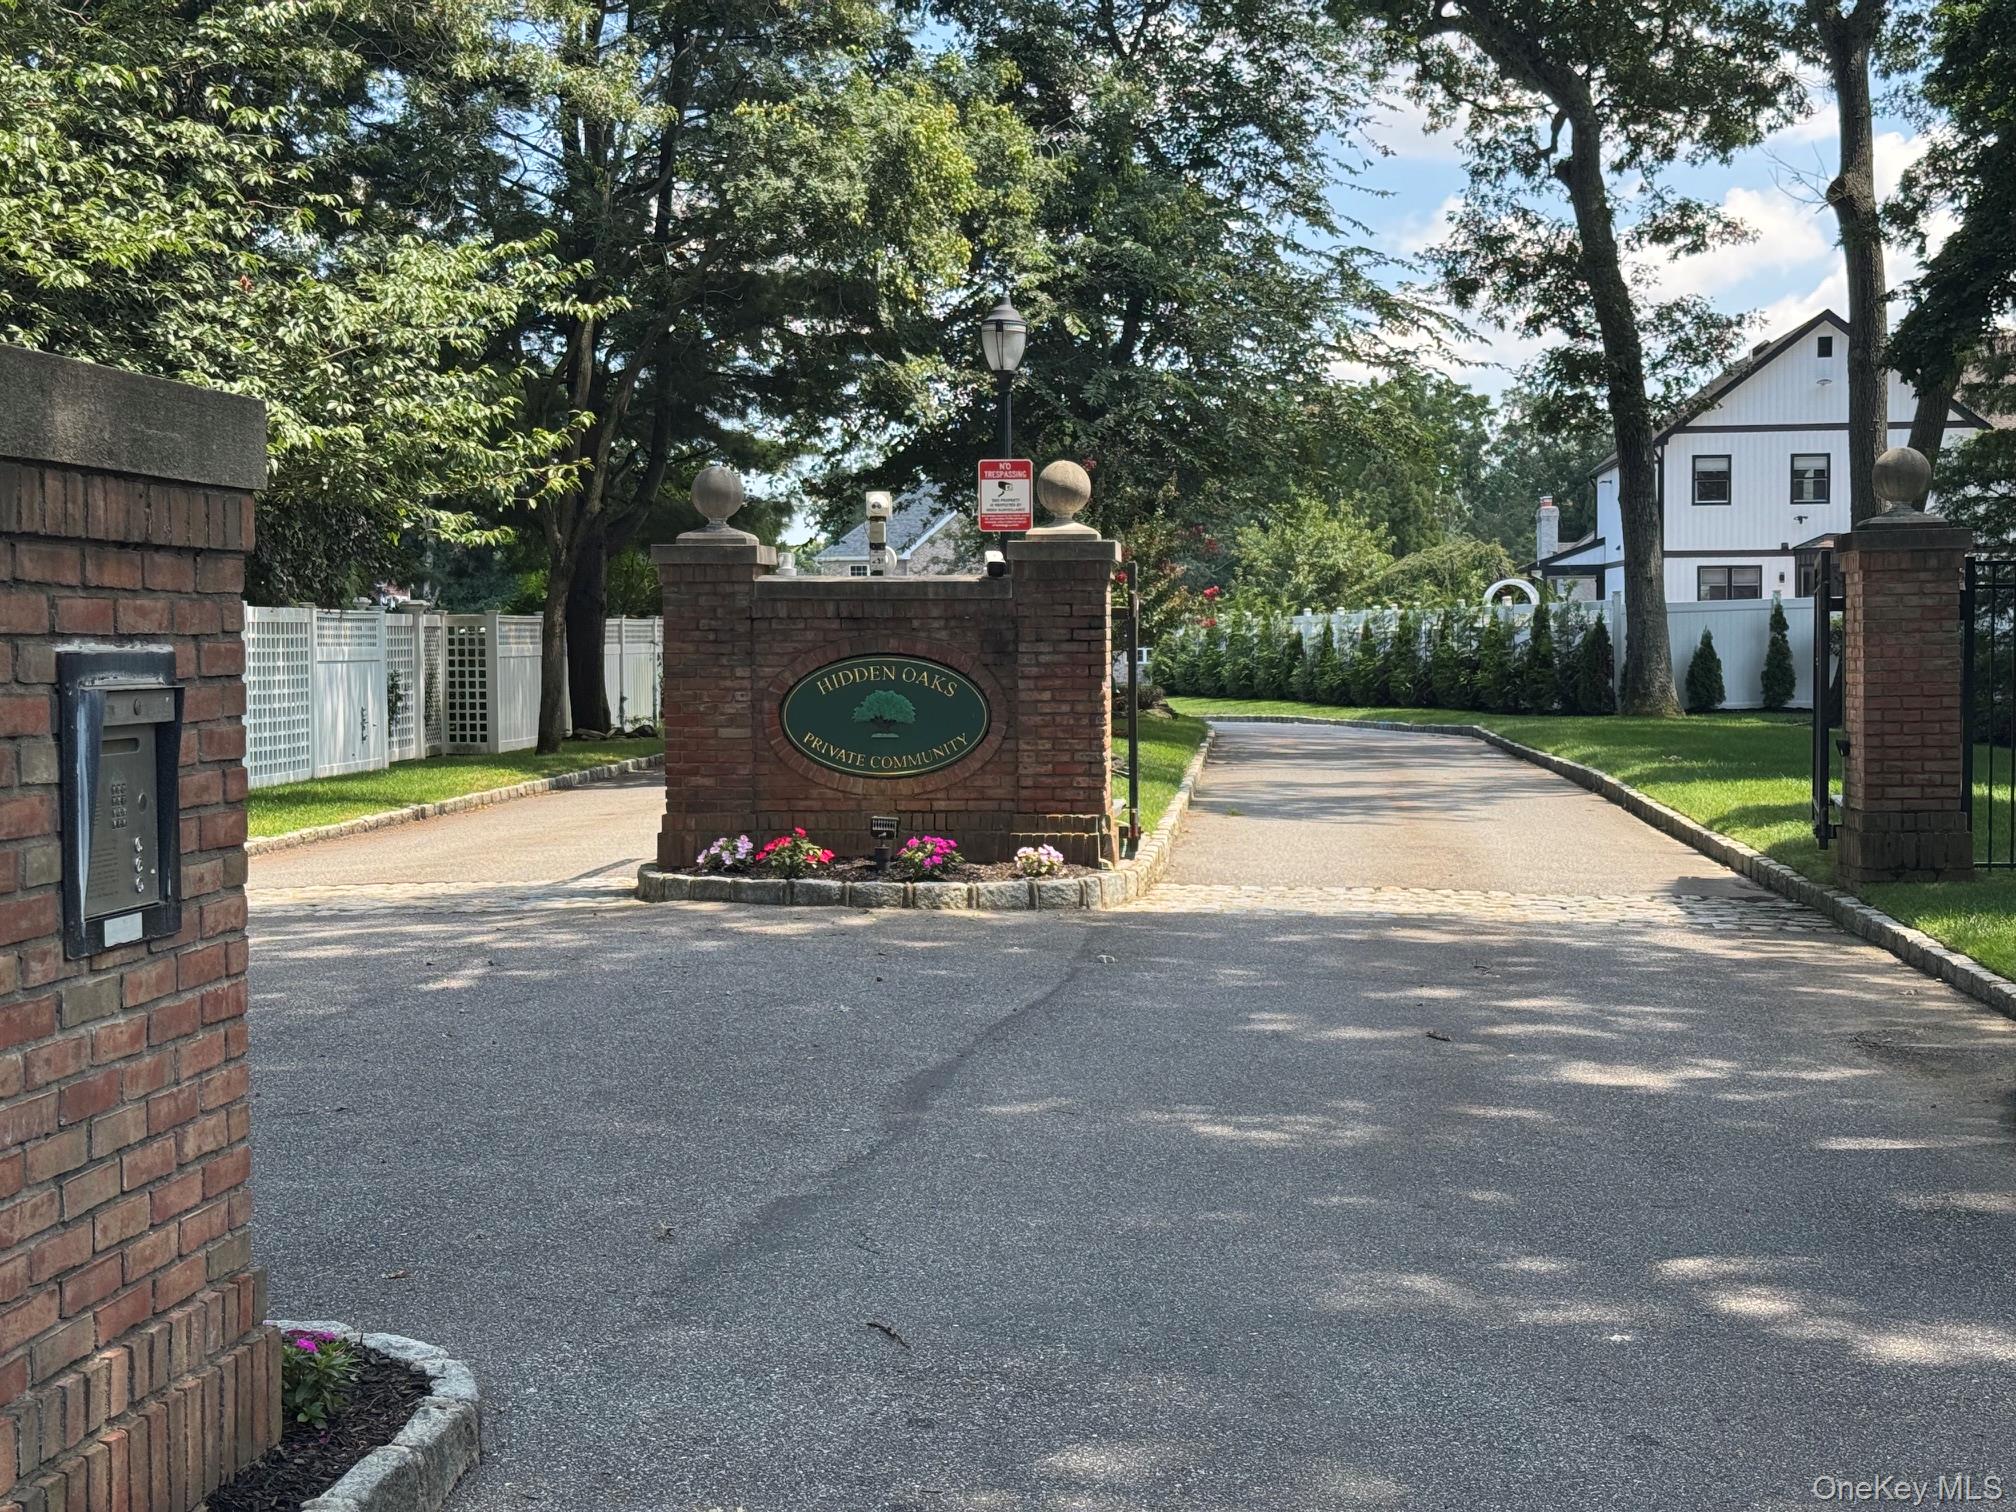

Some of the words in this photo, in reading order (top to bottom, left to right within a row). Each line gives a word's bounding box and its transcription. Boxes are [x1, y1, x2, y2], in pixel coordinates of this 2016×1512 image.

[816, 665, 895, 695] HIDDEN
[902, 666, 958, 697] OAKS
[803, 732, 865, 767] PRIVATE
[870, 733, 967, 768] COMMUNITY
